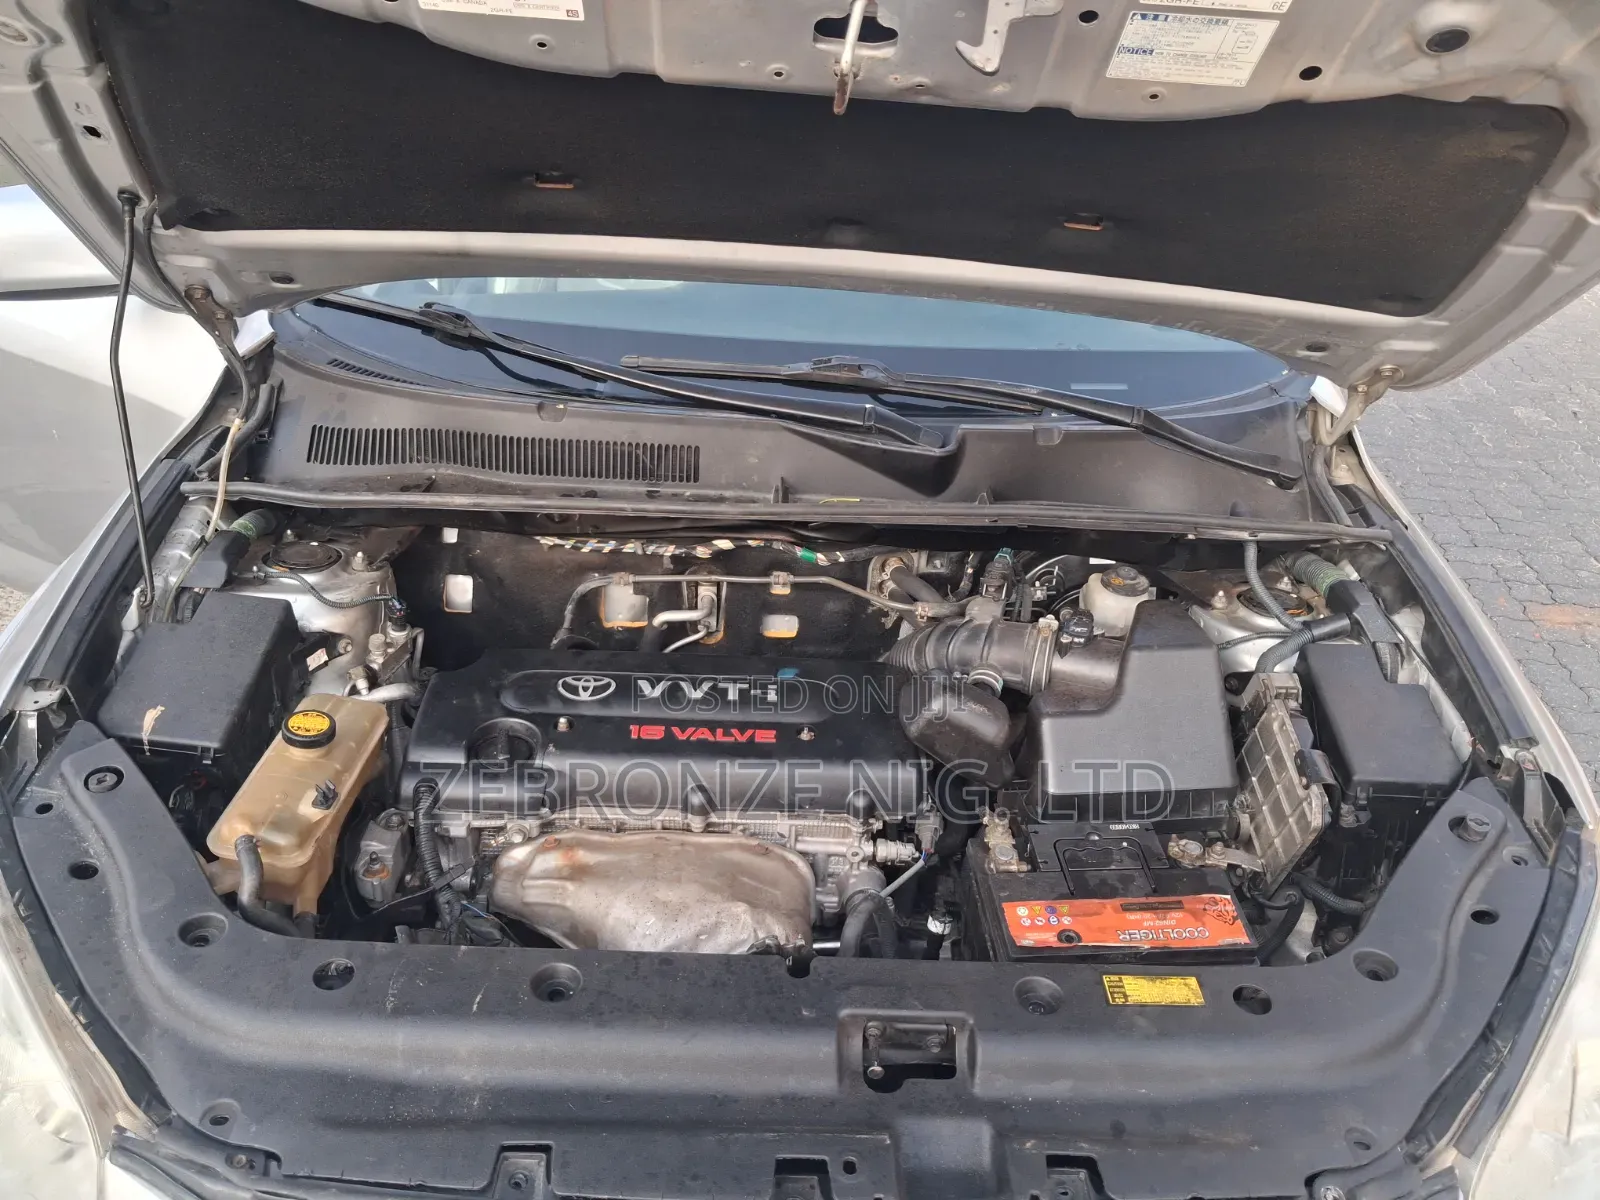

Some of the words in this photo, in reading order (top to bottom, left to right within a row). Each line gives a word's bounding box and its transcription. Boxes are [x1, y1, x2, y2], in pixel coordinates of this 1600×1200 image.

[1272, 1, 1287, 11] 6E
[1119, 47, 1152, 56] NOTICE
[637, 679, 778, 702] VVT-i
[630, 724, 665, 740] 16
[671, 726, 777, 743] VALVE
[1115, 927, 1210, 942] COOLTIGER
